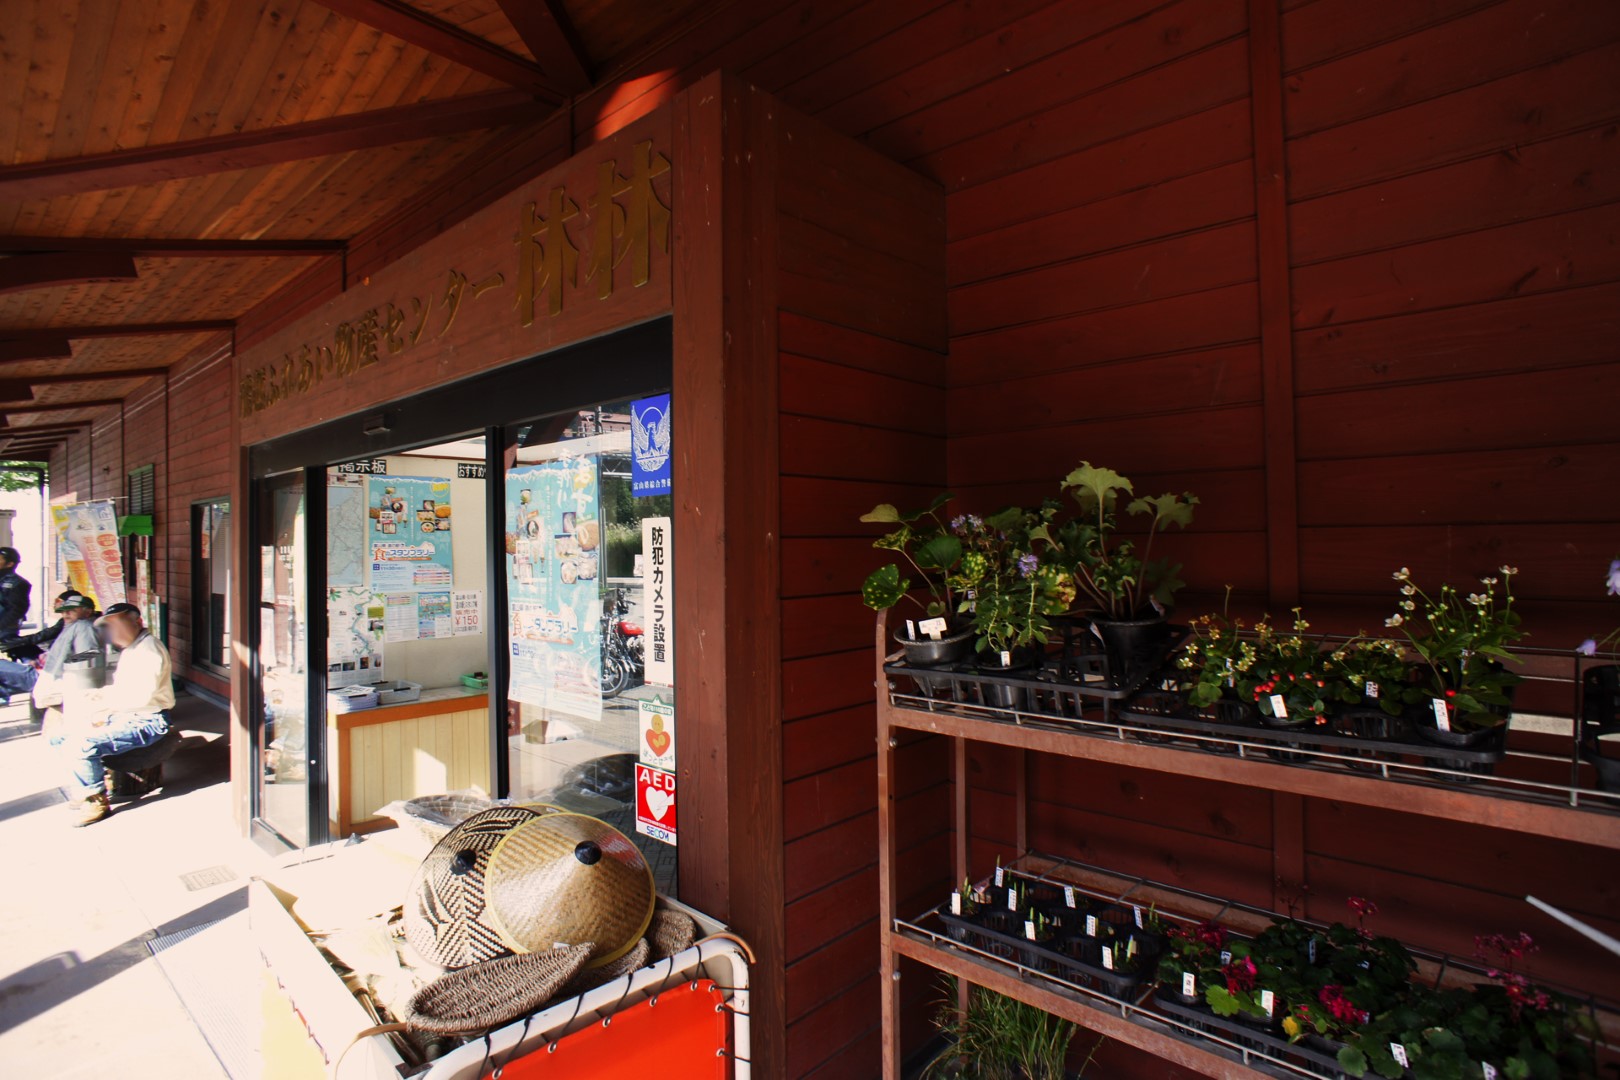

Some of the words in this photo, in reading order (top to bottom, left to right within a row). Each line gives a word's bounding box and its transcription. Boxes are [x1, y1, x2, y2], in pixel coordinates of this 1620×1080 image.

[459, 465, 487, 478] おすすめ
[651, 526, 666, 663] 防犯カメラ設置
[639, 768, 676, 791] AED
[646, 825, 669, 842] SECOM
